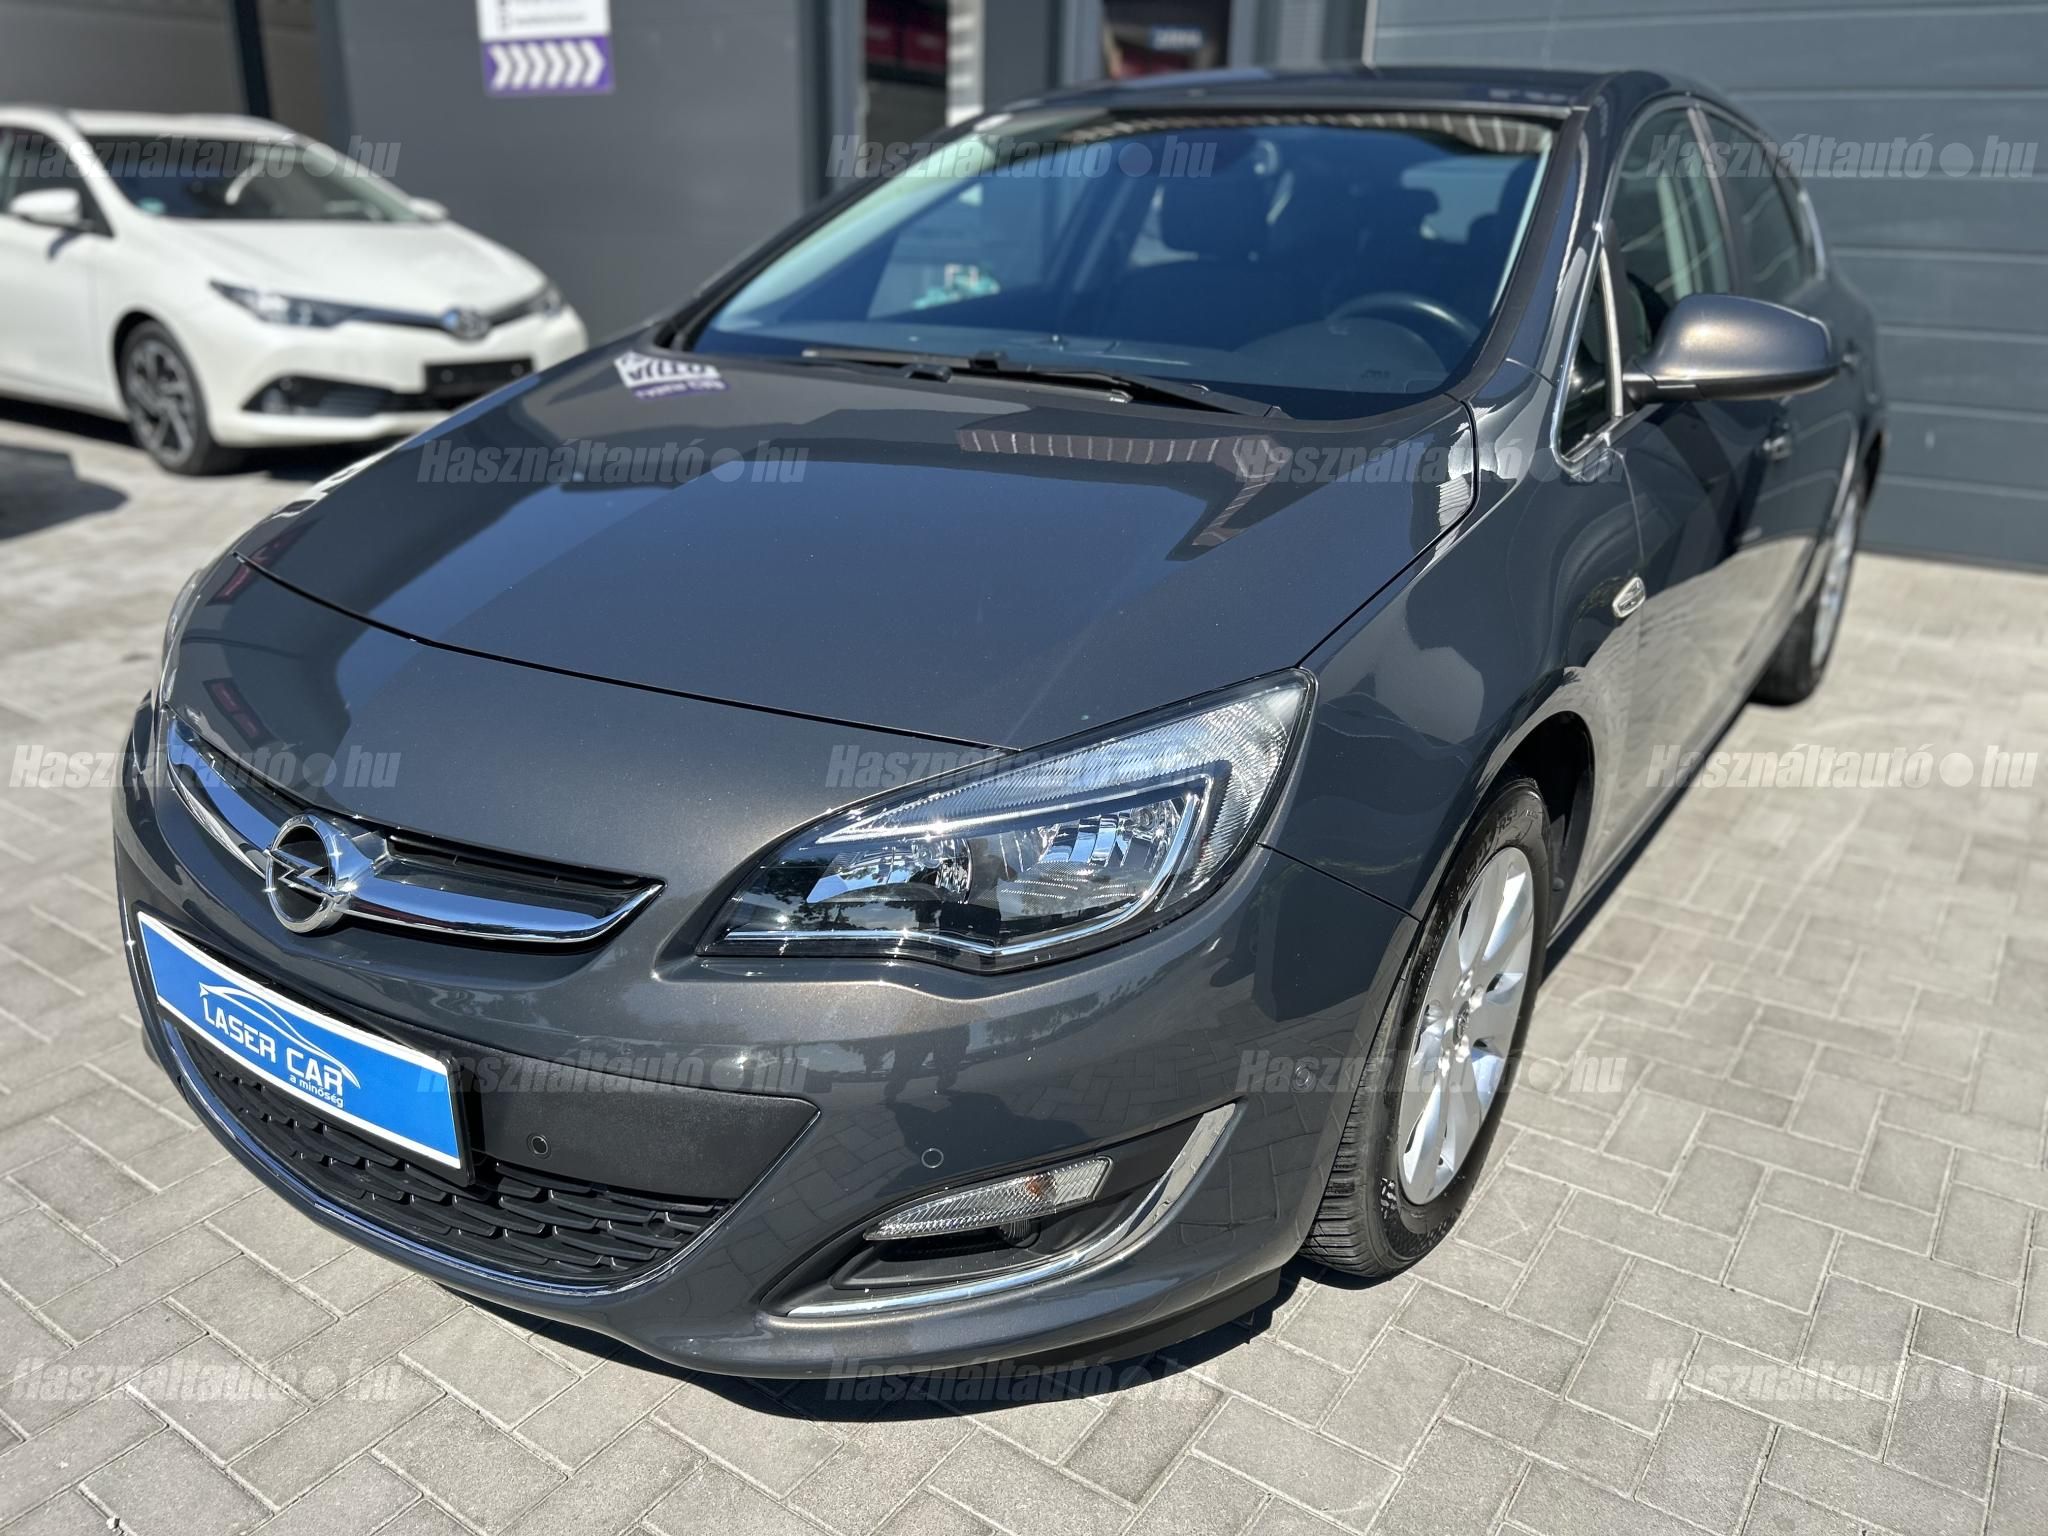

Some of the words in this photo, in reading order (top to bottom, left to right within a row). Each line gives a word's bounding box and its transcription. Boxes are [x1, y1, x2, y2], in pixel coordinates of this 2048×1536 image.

[203, 997, 276, 1064] LASER
[286, 1047, 344, 1097] CAR
[289, 1074, 297, 1084] a
[299, 1079, 344, 1109] minőség
